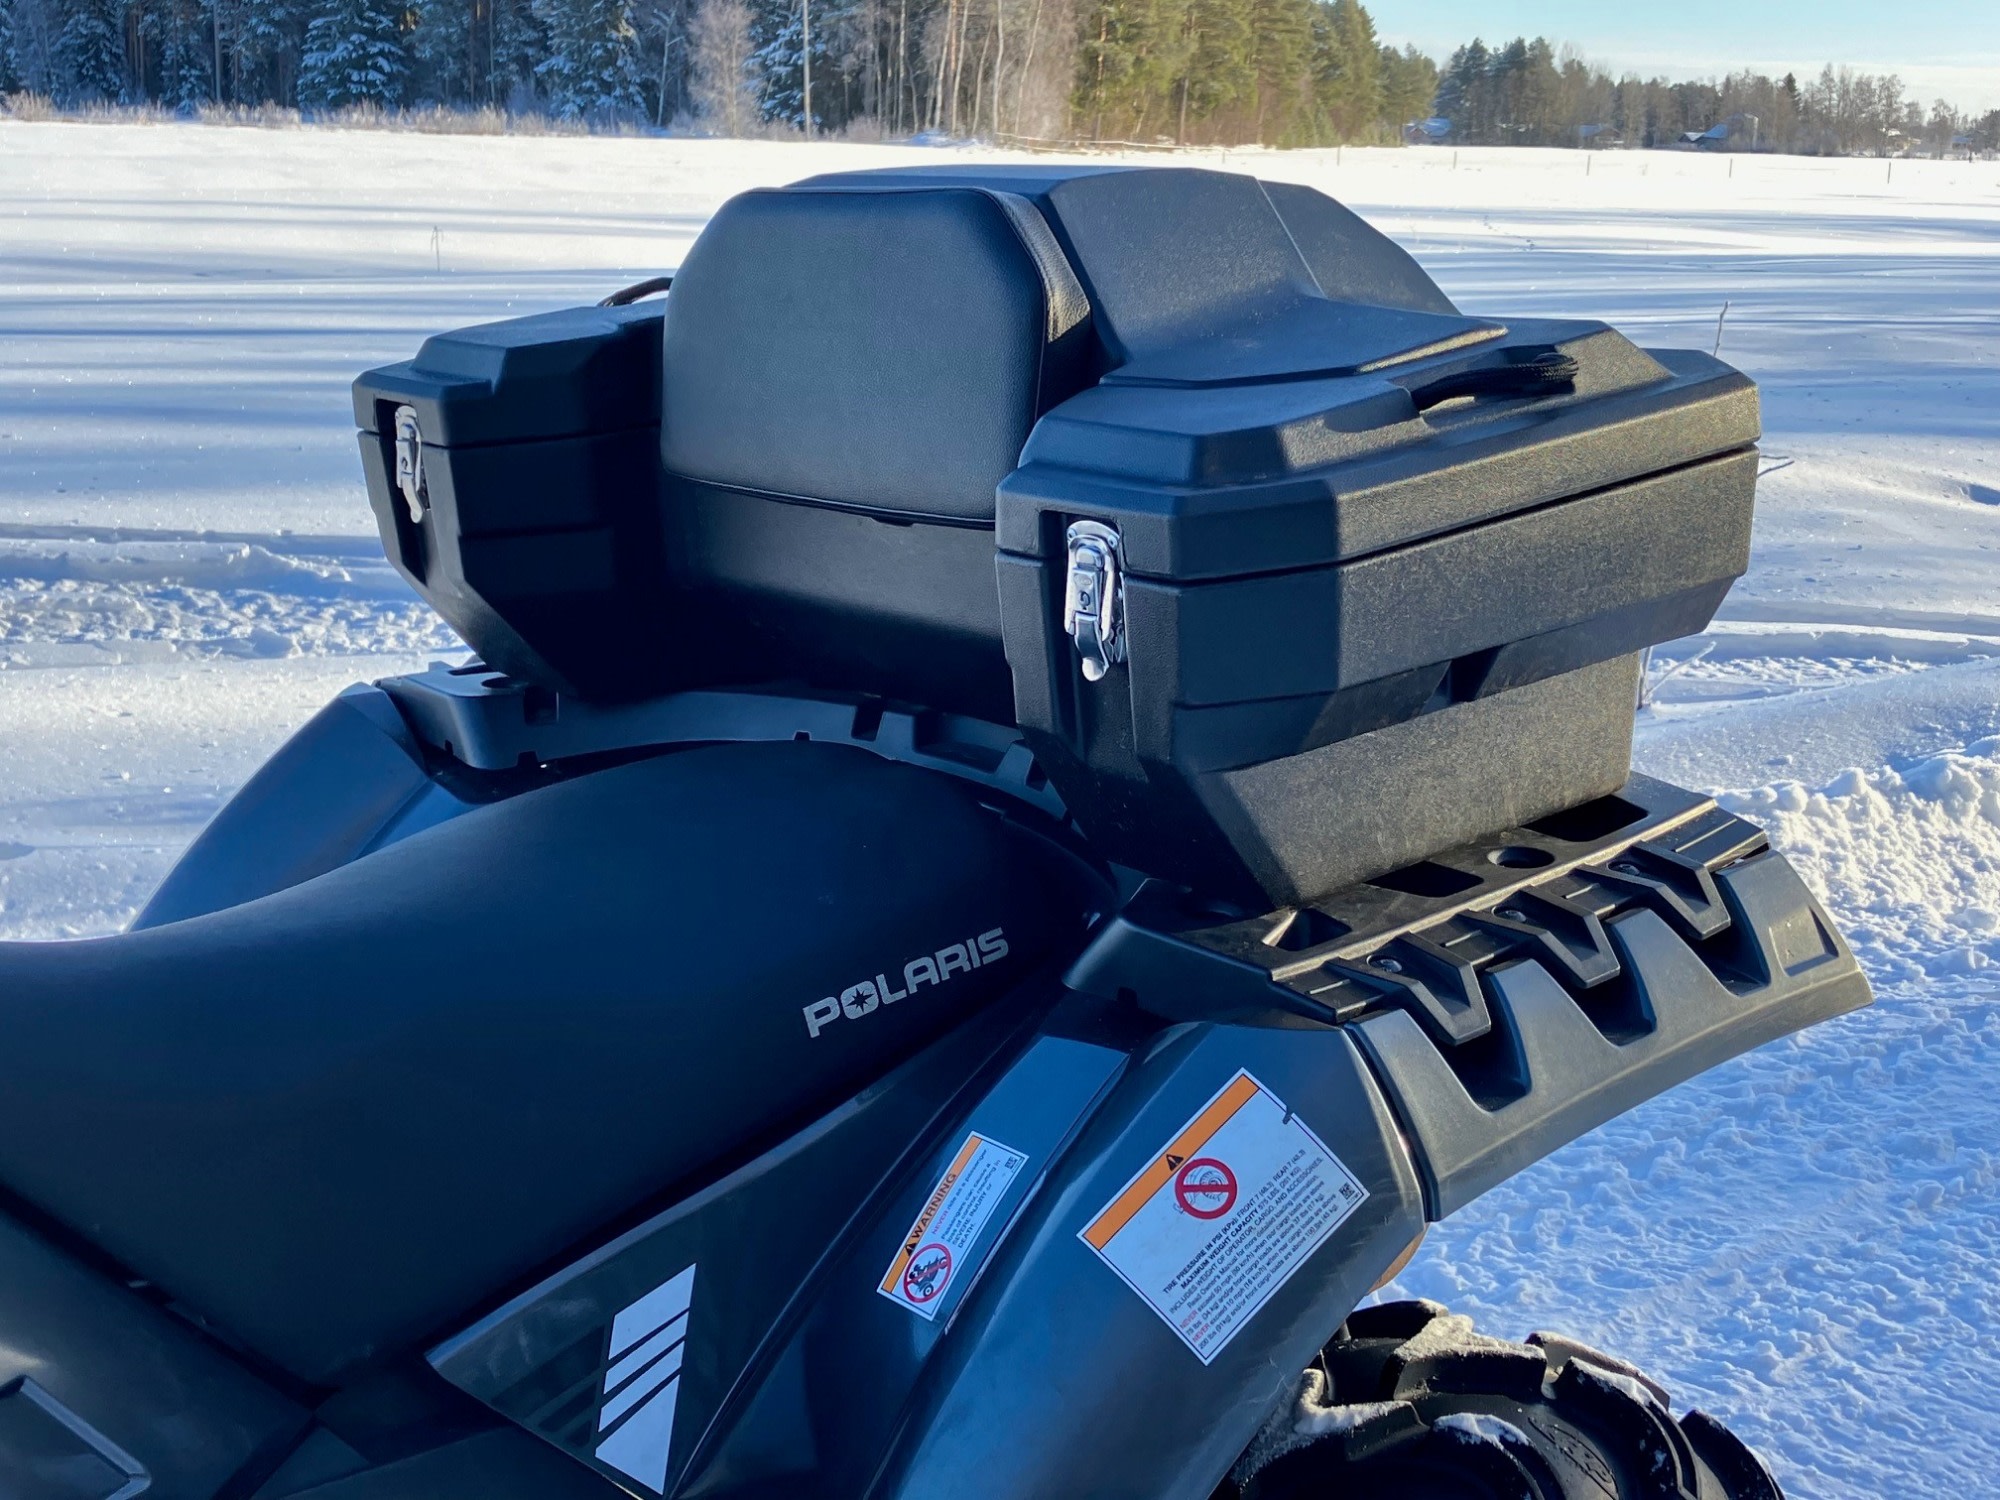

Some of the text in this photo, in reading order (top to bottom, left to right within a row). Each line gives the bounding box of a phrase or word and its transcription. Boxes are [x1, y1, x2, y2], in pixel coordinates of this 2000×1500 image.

[803, 926, 1009, 1039] POLARIS
[911, 1171, 956, 1240] WARNING
[931, 1210, 948, 1234] NEVER
[946, 1196, 957, 1210] ride
[940, 1200, 967, 1240] Passengers
[964, 1189, 974, 1201] can
[973, 1168, 987, 1187] cause
[946, 1227, 957, 1242] loss
[955, 1219, 962, 1227] of
[951, 1216, 971, 1245] SEVERE
[969, 1191, 987, 1216] INJURY
[1162, 1279, 1177, 1294] TIRE
[1175, 1248, 1206, 1281] PRESSURE
[1204, 1242, 1213, 1251] IN
[1211, 1232, 1223, 1244] PSI
[1236, 1198, 1256, 1218] FRONT
[1272, 1164, 1288, 1181] REAR
[1168, 1284, 1197, 1314] INCLUDES
[1195, 1263, 1218, 1286] WEIGHT
[1216, 1254, 1227, 1265] OF
[1224, 1224, 1256, 1257] OPERATOR,
[1273, 1191, 1288, 1206] AND
[1285, 1155, 1323, 1194] ACCESSORIES.
[1179, 1309, 1198, 1329] NEVER
[1195, 1291, 1215, 1312] exceed
[1213, 1285, 1222, 1294] 50
[1219, 1273, 1234, 1288] mph
[1238, 1251, 1255, 1269] km/h)
[1252, 1238, 1267, 1254] when
[1265, 1229, 1277, 1241] rear
[1275, 1215, 1291, 1231] cargo
[1288, 1201, 1303, 1217] loads
[1301, 1194, 1311, 1204] are
[1308, 1179, 1324, 1196] above
[1180, 1258, 1209, 1289] MAXIMUM
[1207, 1235, 1232, 1260] WEIGHT
[1229, 1207, 1259, 1237] CAPACITY
[1186, 1292, 1202, 1308] Read
[1199, 1273, 1221, 1295] Owner's
[1219, 1255, 1238, 1275] Manual
[1236, 1247, 1245, 1257] for
[1243, 1235, 1257, 1250] more
[1255, 1216, 1276, 1237] detailed
[1273, 1198, 1294, 1219] loading
[1191, 1322, 1210, 1342] NEVER
[1208, 1305, 1228, 1325] exceed
[1226, 1298, 1234, 1307] 10
[1232, 1287, 1246, 1301] mph
[1251, 1264, 1267, 1282] km/h)
[1264, 1251, 1279, 1267] when
[1277, 1242, 1289, 1254] rear
[1287, 1228, 1303, 1245] cargo
[1300, 1215, 1314, 1230] loads
[1313, 1207, 1323, 1217] are
[1320, 1193, 1336, 1209] above
[1197, 1337, 1209, 1349] 200
[1206, 1329, 1217, 1340] lbs
[1229, 1298, 1247, 1316] and/or
[1244, 1286, 1258, 1300] front
[1256, 1272, 1273, 1289] cargo
[1269, 1258, 1285, 1274] loads
[1283, 1251, 1292, 1261] are
[1290, 1235, 1307, 1252] above
[1313, 1219, 1323, 1229] lbs
[1217, 1285, 1234, 1303] and/or
[1232, 1273, 1246, 1287] front
[1244, 1259, 1261, 1276] cargo
[1257, 1245, 1272, 1261] loads
[1271, 1238, 1280, 1247] are
[1278, 1222, 1294, 1239] above
[1299, 1208, 1308, 1218] lbs
